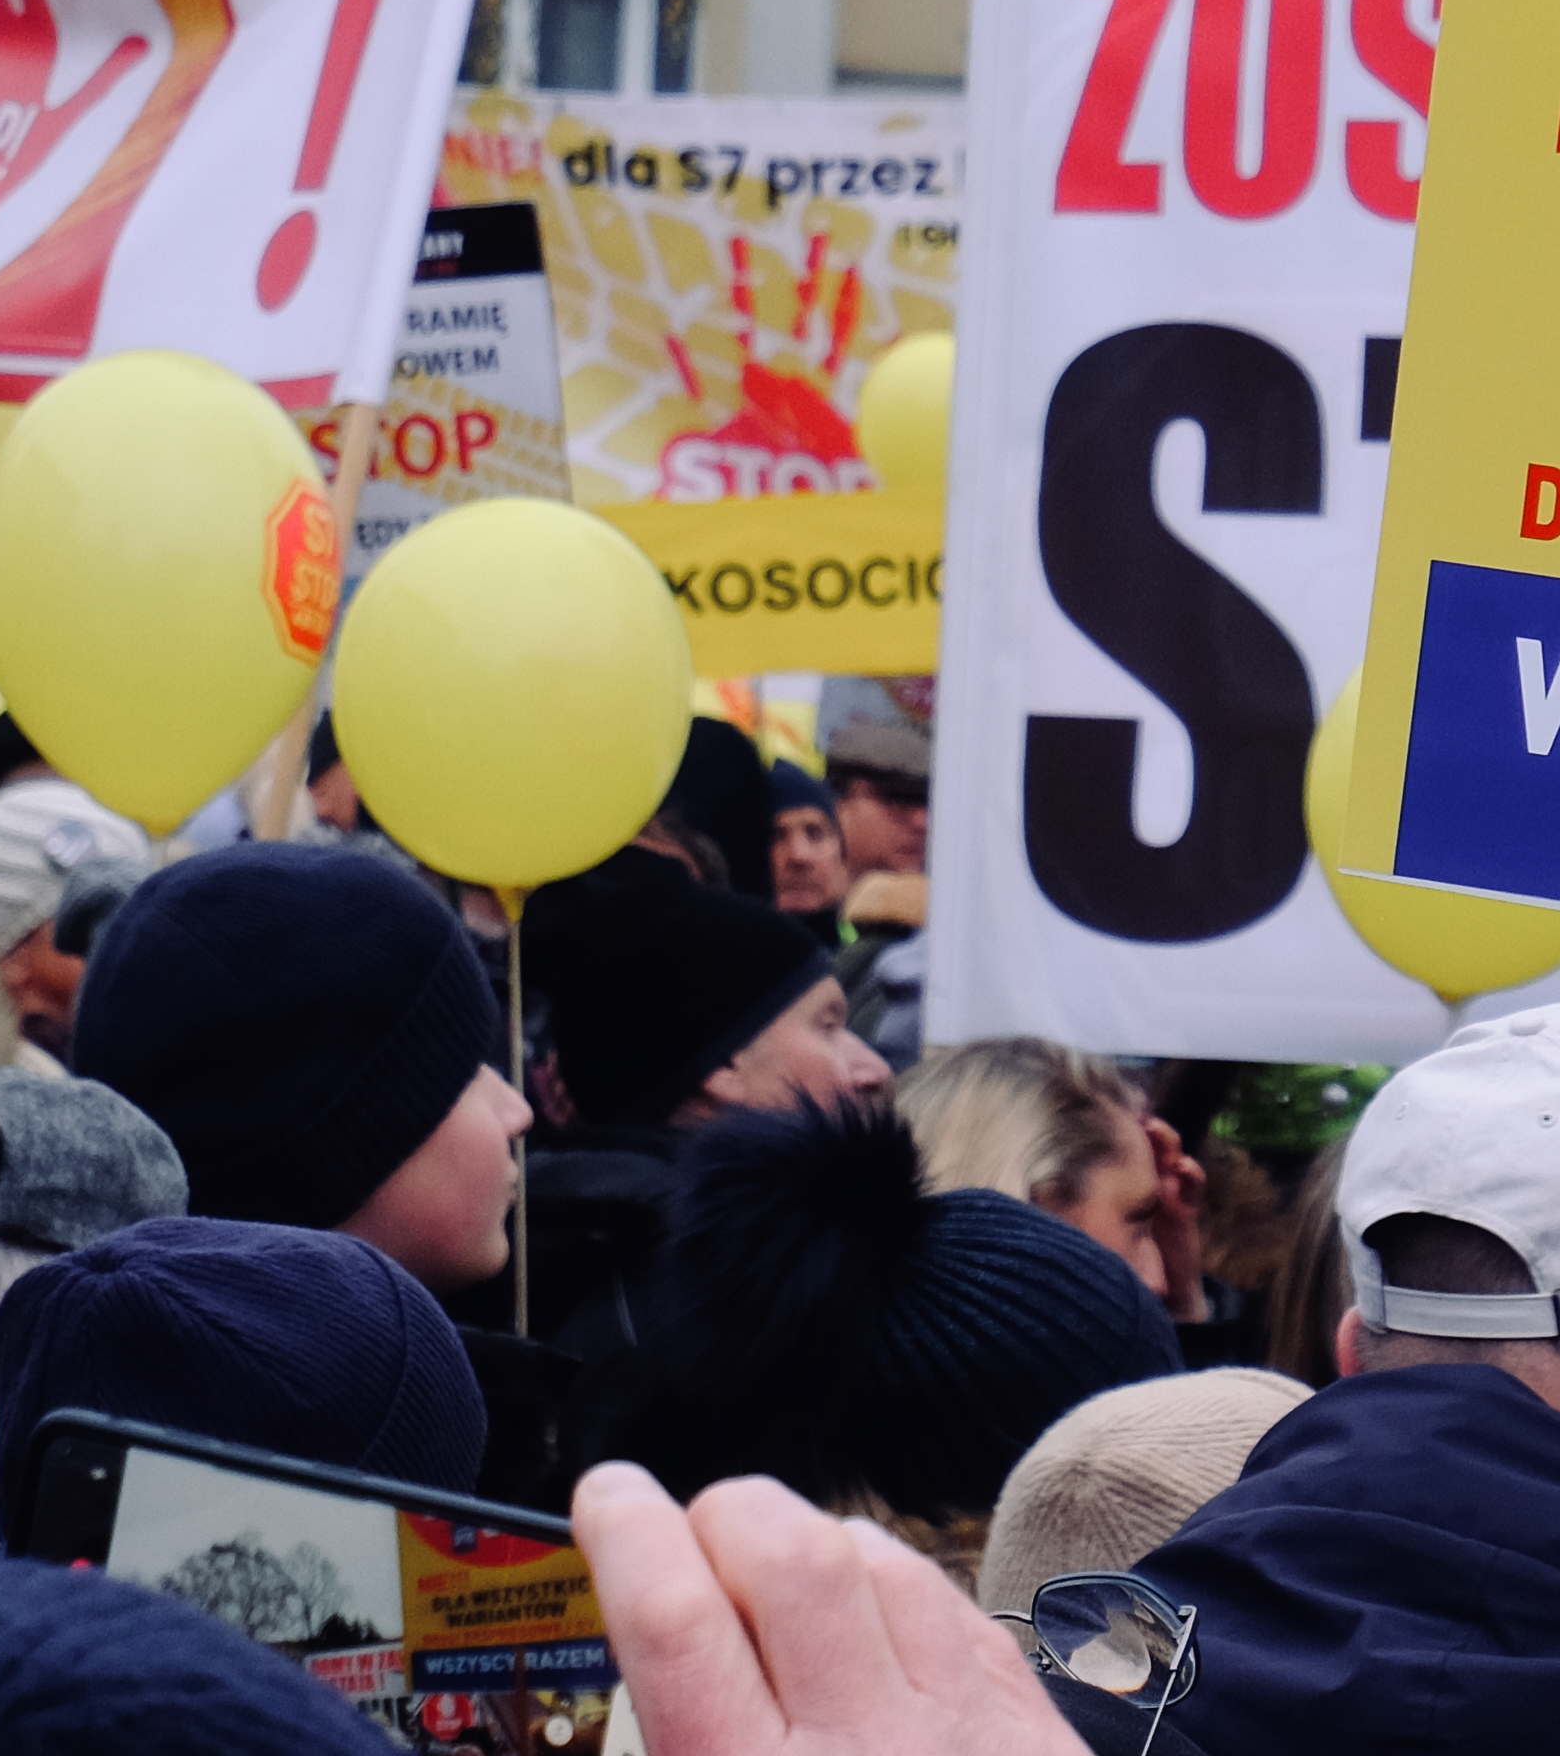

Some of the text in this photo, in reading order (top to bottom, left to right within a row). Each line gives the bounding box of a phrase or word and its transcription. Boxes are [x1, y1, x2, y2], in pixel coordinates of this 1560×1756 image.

[561, 141, 659, 190] dla
[682, 144, 746, 196] S7
[764, 152, 944, 210] przez
[308, 409, 498, 486] SOP
